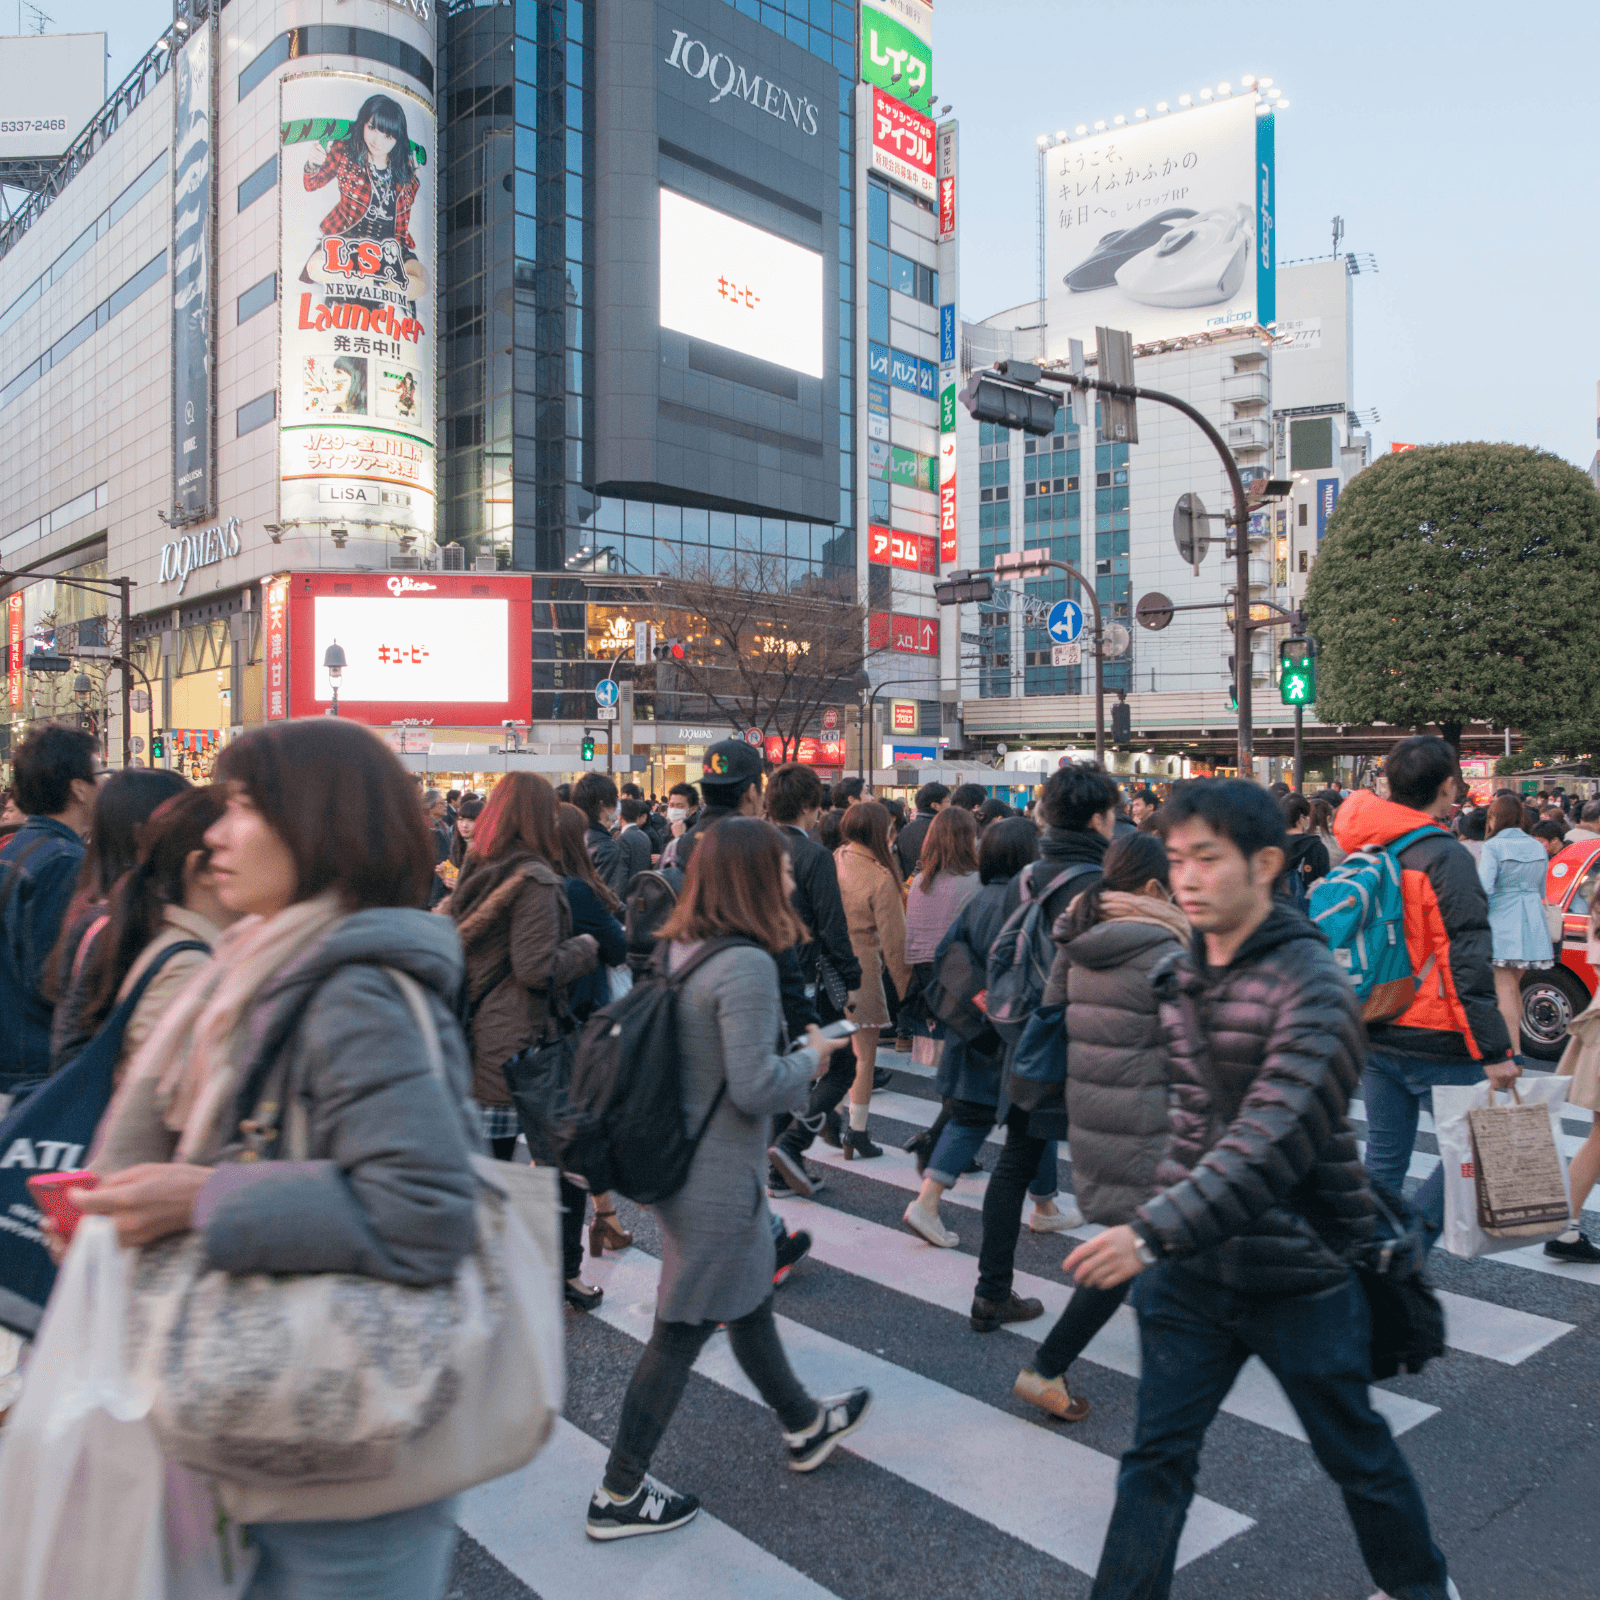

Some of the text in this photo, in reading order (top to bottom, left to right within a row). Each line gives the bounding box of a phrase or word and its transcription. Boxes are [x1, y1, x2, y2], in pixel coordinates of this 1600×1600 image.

[870, 28, 926, 88] レイク
[1, 119, 66, 132] 5337-2468
[877, 98, 932, 138] キャッシングなら
[876, 112, 933, 165] アイフル
[1059, 151, 1198, 202] キレイふかふかの
[943, 188, 953, 233] アイフル
[1059, 204, 1117, 230] 毎日へ。
[326, 283, 408, 307] NEW ALBUM
[298, 292, 426, 345] Launcher
[334, 335, 401, 360] 発売中!!
[869, 350, 934, 392] レオパレス21
[944, 395, 953, 426] レイク
[874, 426, 883, 436] 6F
[891, 456, 918, 477] レイク
[330, 487, 368, 501] LiSA
[942, 487, 955, 530] アコム
[873, 534, 918, 562] アコム
[386, 576, 438, 598] Glico
[897, 634, 913, 649] 入口
